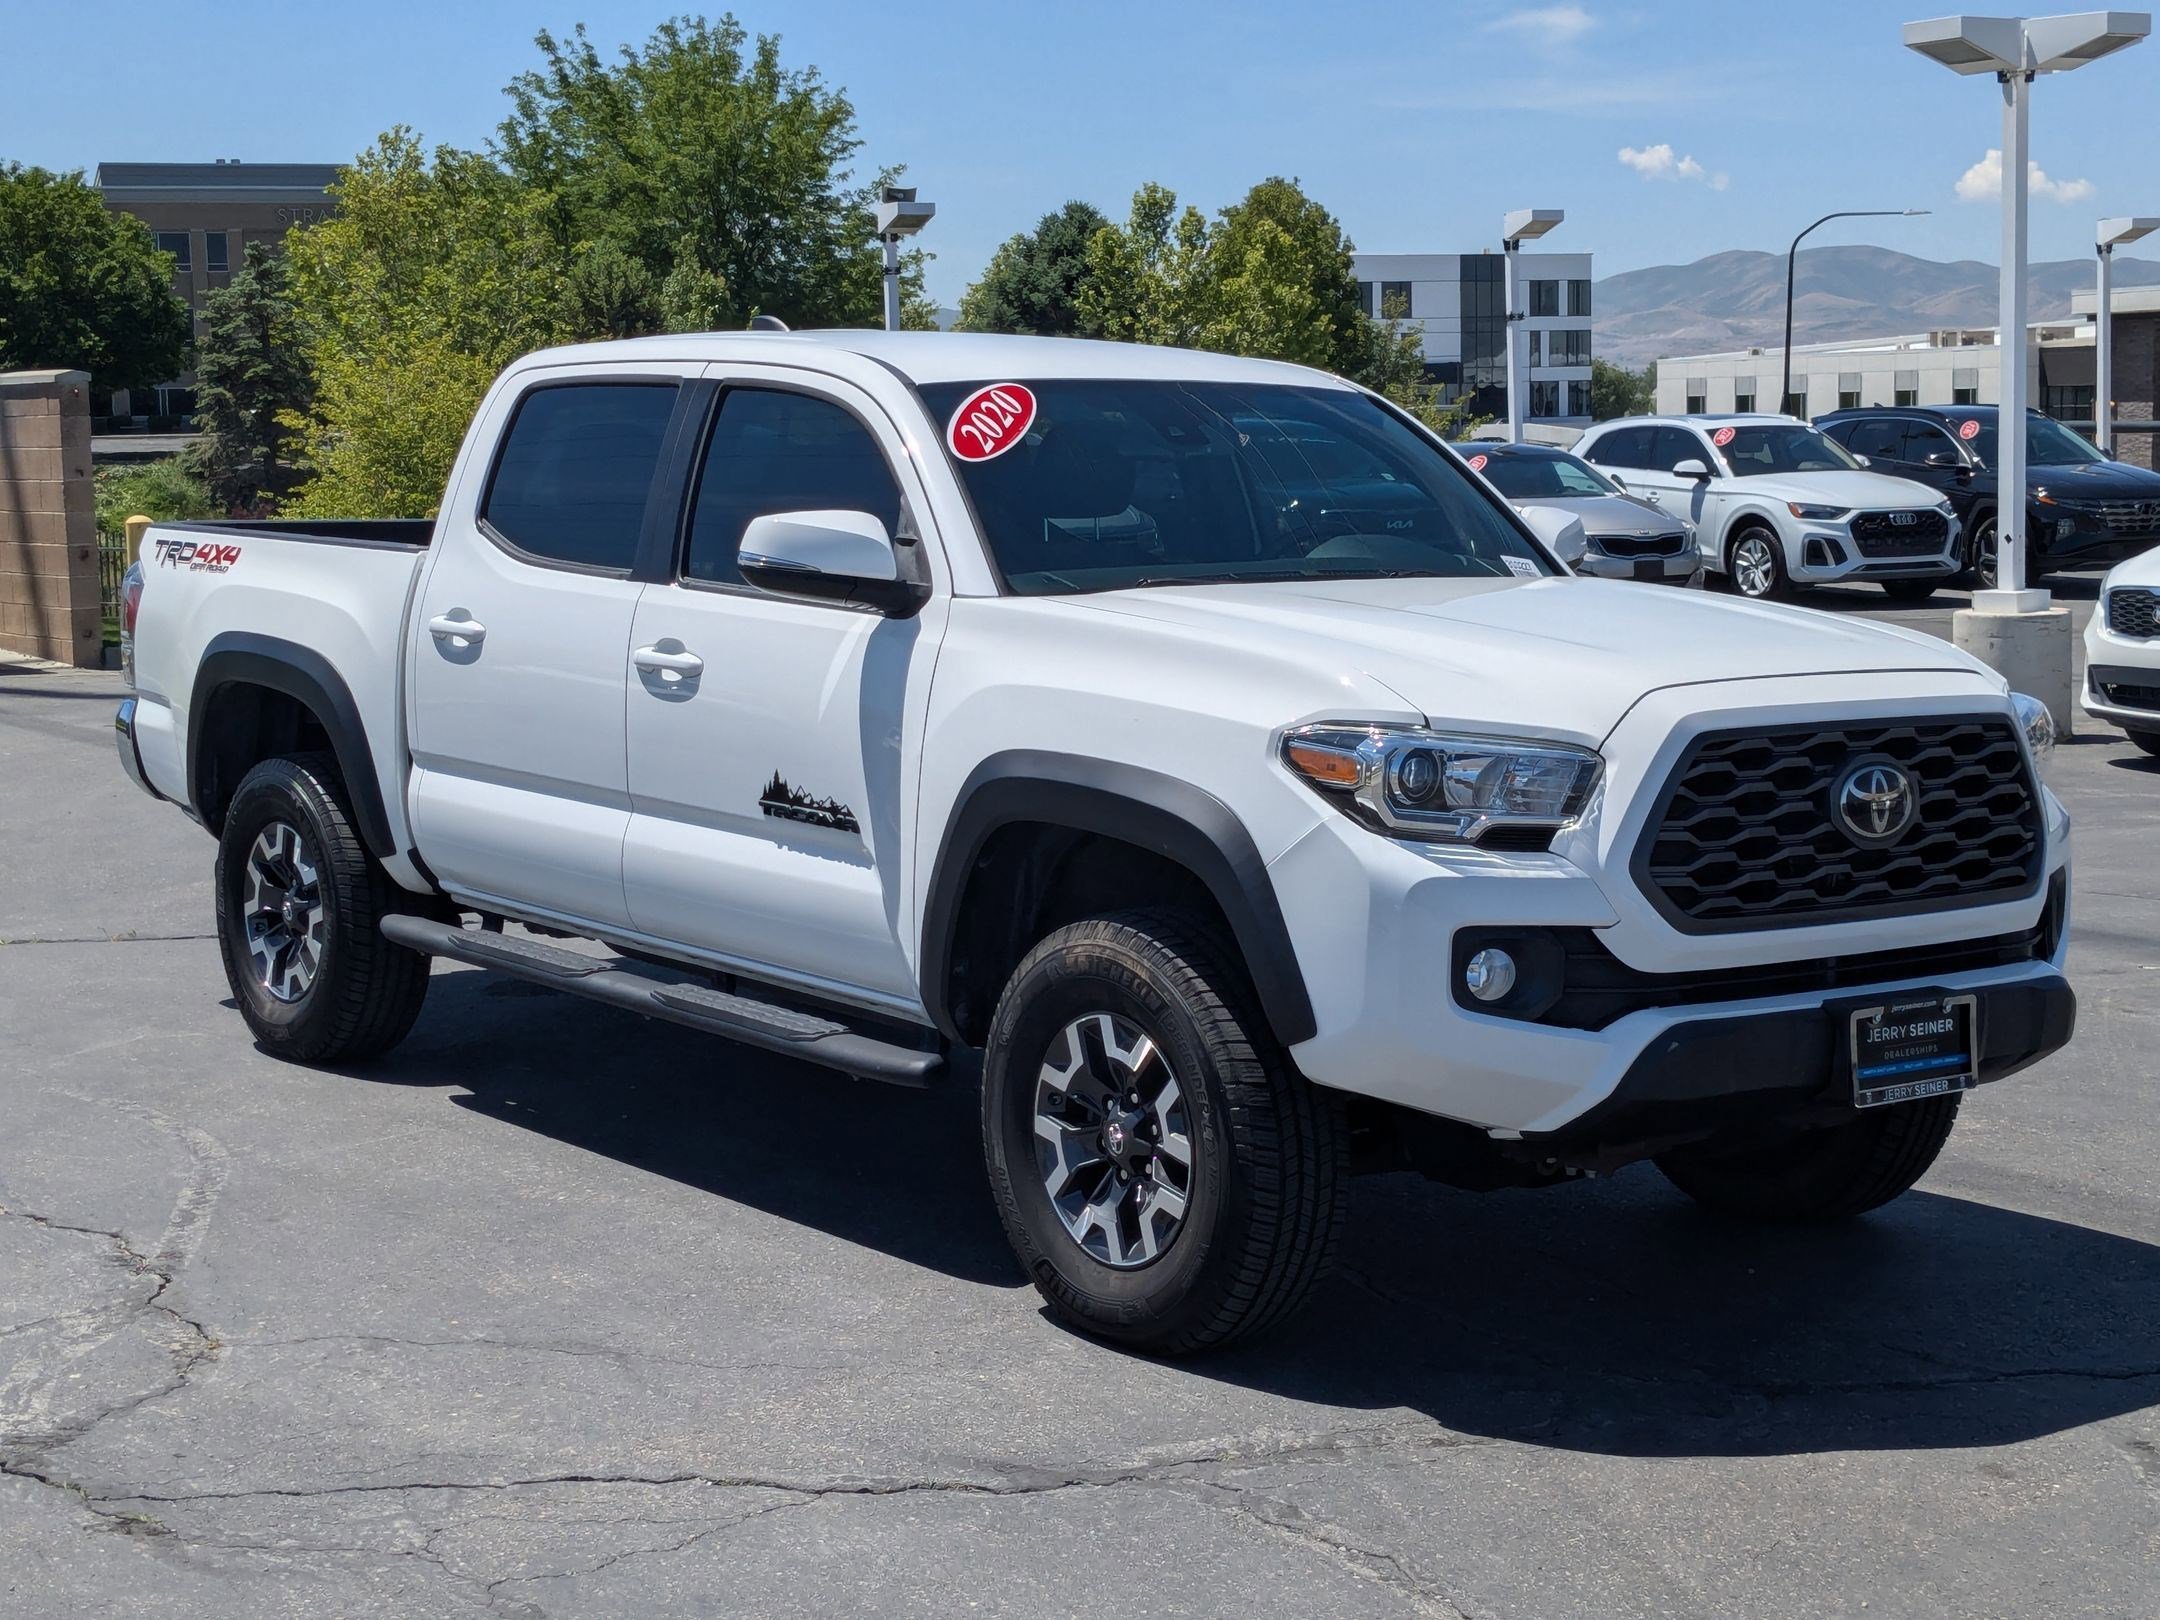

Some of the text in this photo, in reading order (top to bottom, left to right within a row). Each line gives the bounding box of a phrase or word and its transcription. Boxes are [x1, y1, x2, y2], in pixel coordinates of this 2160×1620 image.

[961, 390, 1022, 454] 2020
[1867, 1018, 1954, 1043] JERRY SEINER
[1884, 1045, 1938, 1060] DEALERSHIPS
[1883, 1080, 1949, 1101] JERRY SEINER
